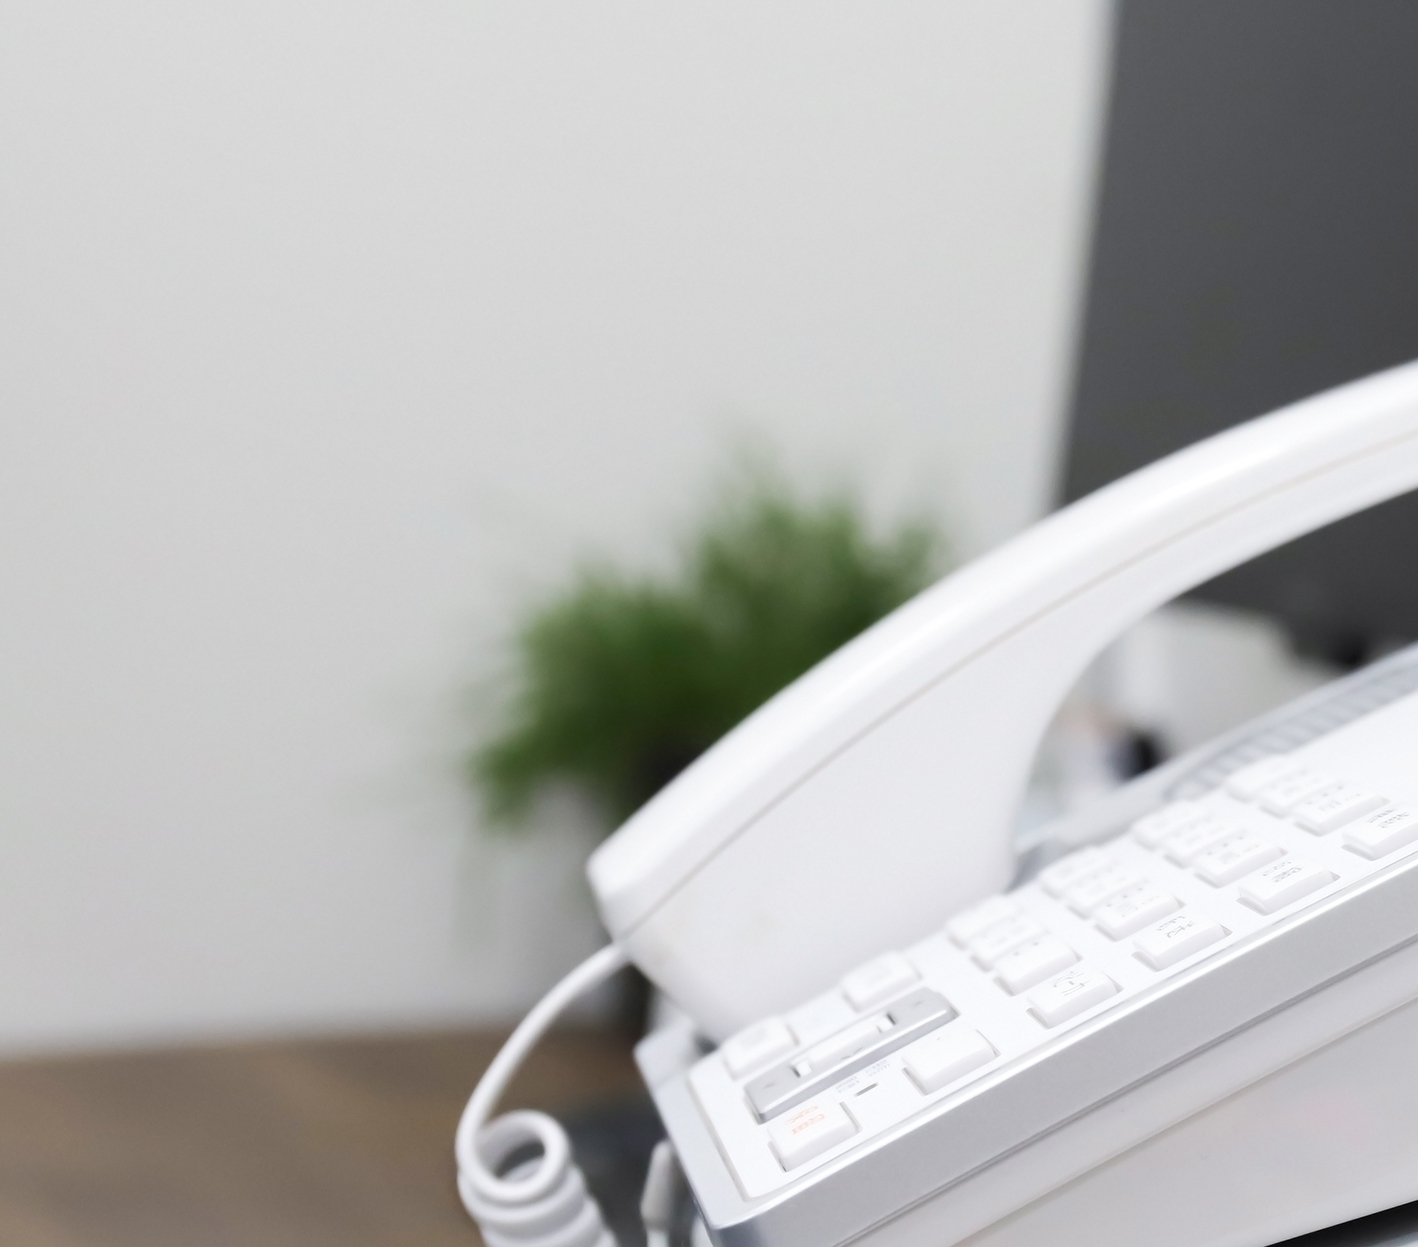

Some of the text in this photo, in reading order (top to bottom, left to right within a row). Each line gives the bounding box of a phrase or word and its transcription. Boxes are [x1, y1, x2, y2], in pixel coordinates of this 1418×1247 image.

[1048, 970, 1091, 997] スピーカ
[784, 1104, 826, 1136] 保留
